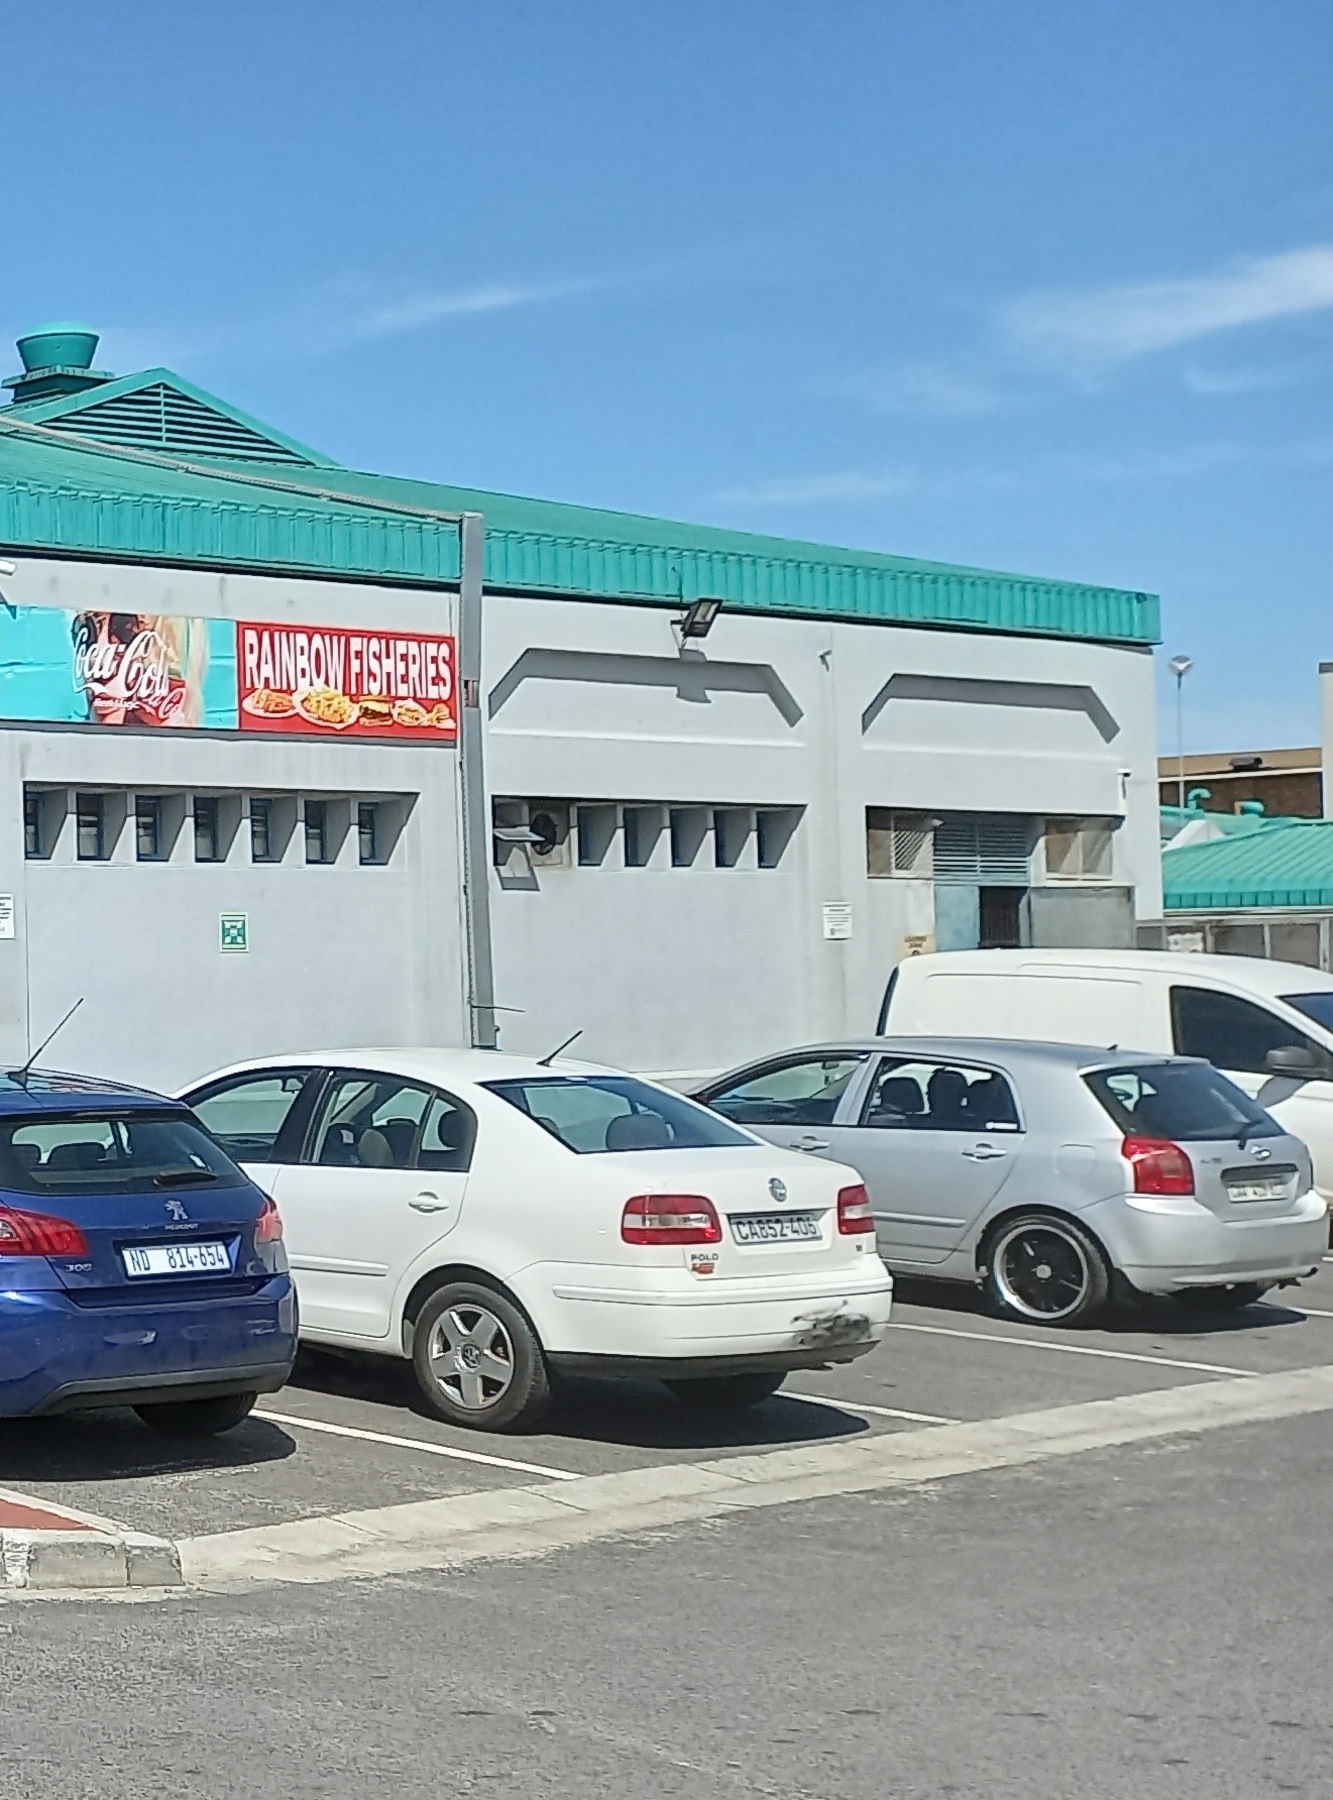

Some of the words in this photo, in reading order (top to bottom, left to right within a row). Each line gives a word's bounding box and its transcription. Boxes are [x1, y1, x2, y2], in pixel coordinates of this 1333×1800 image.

[244, 629, 345, 694] RAINBOW
[349, 636, 452, 700] FISHERIES
[131, 1250, 151, 1272] ND
[167, 1245, 225, 1268] 814-654
[691, 1253, 719, 1262] POLO
